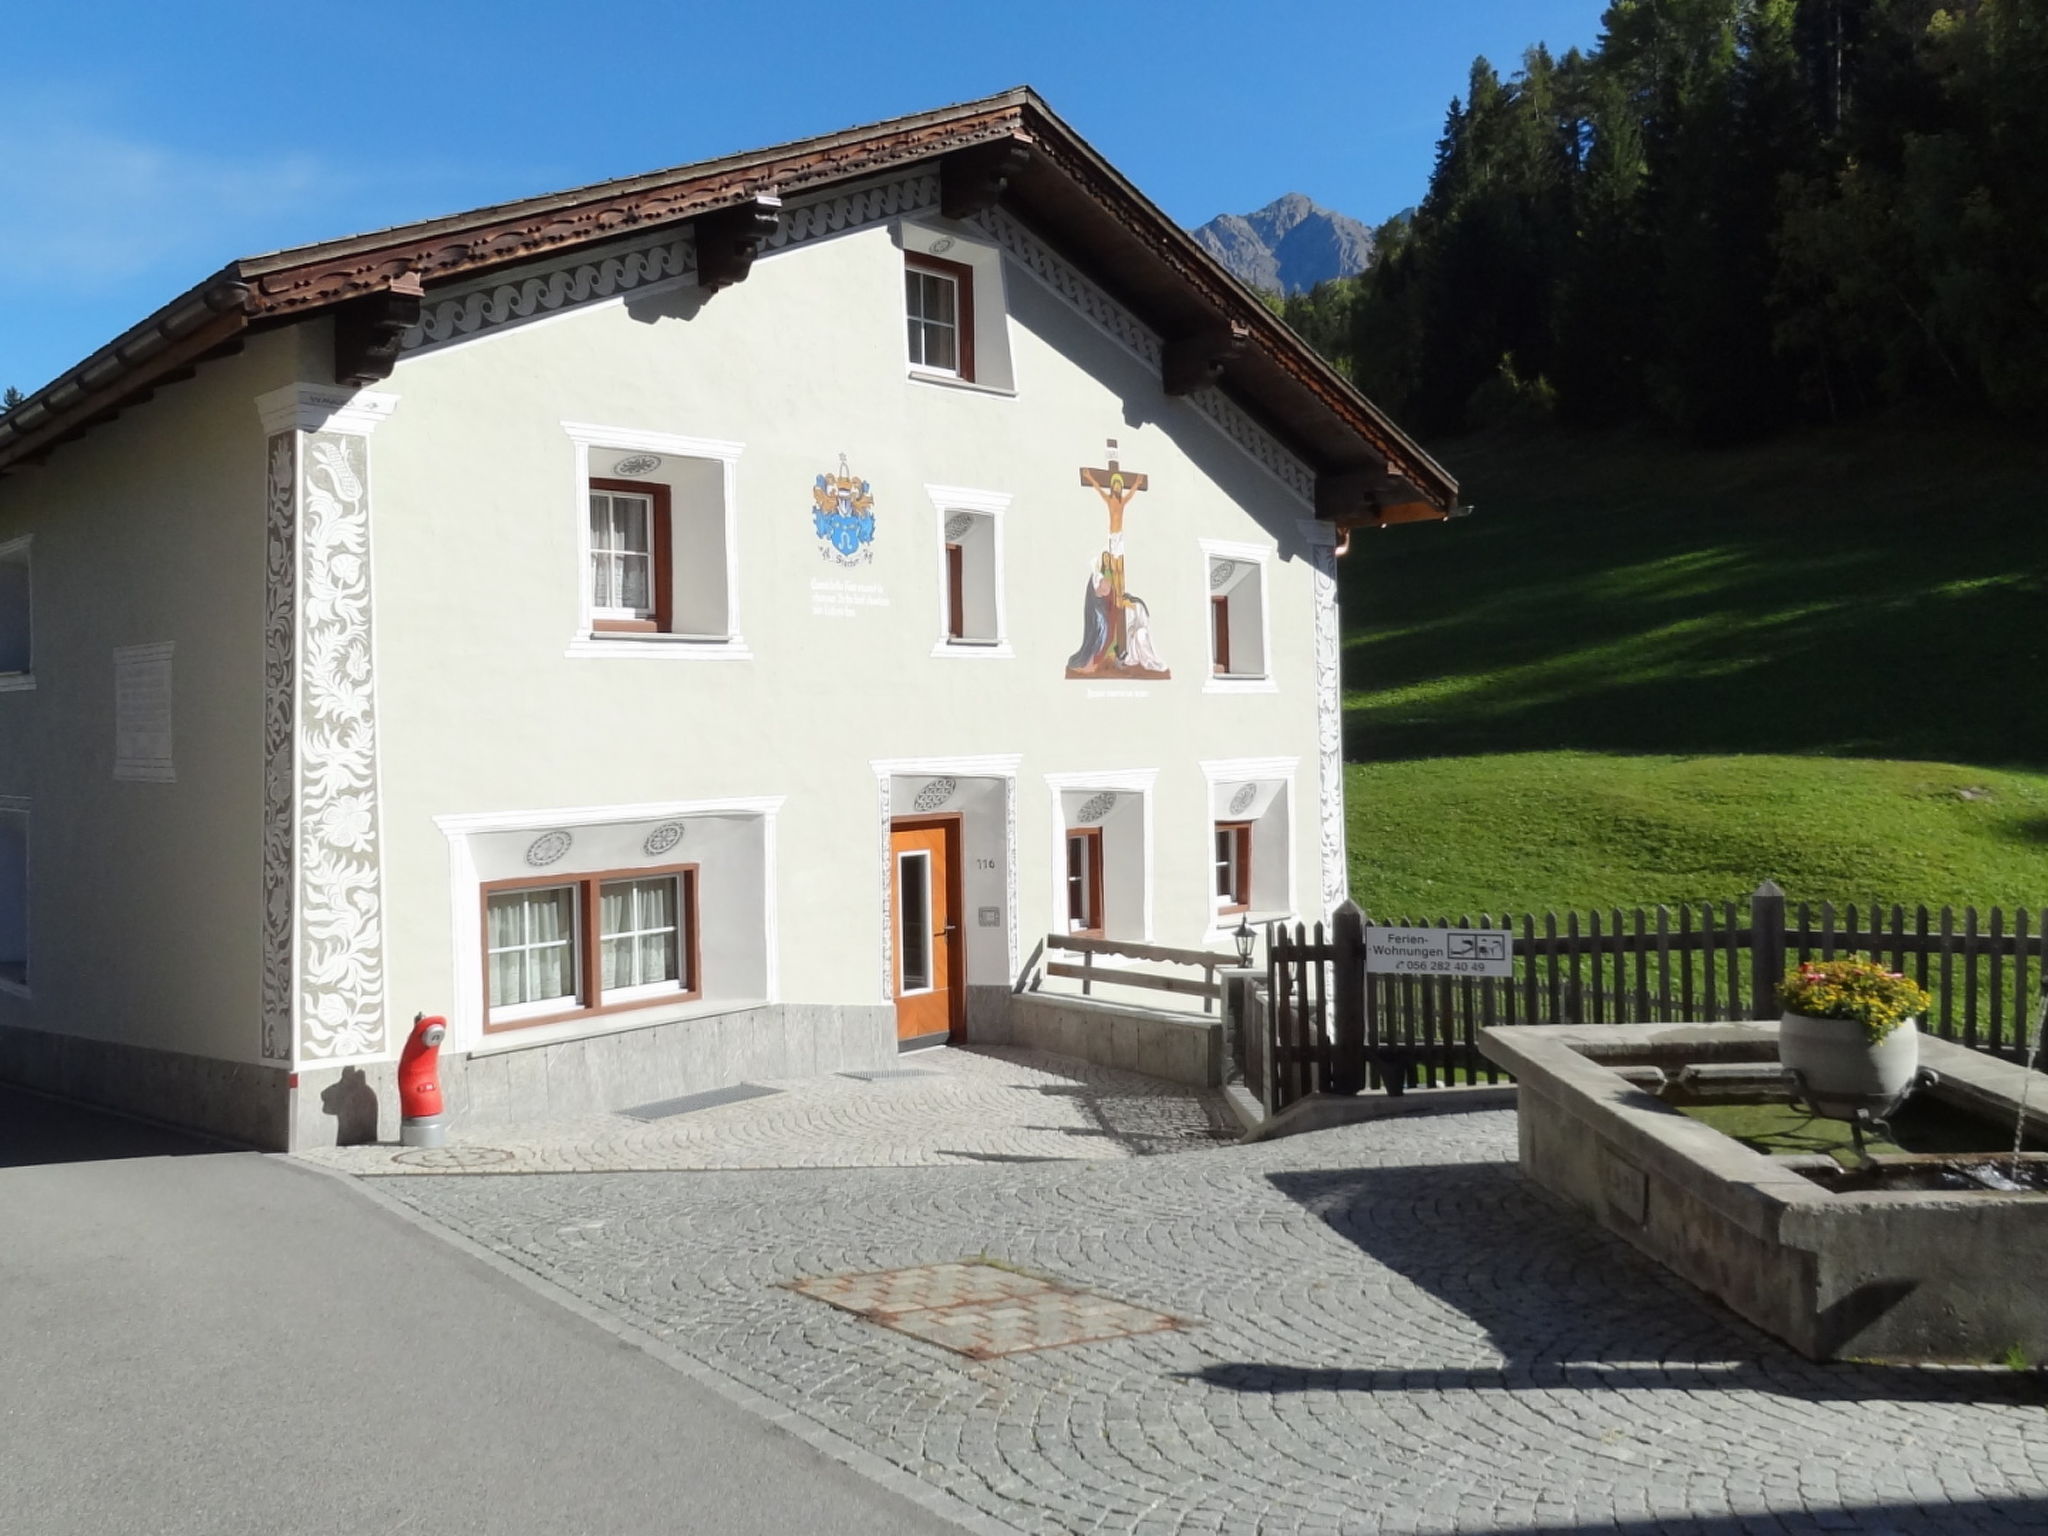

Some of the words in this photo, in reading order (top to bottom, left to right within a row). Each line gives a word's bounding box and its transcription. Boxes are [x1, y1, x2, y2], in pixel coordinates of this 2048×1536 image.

[977, 858, 995, 870] 116
[1387, 933, 1428, 944] Ferien-
[1373, 945, 1443, 957] Wohnungen
[1407, 961, 1427, 970] 056
[1430, 961, 1451, 970] 282
[1454, 962, 1468, 971] 40
[1471, 962, 1485, 971] 49
